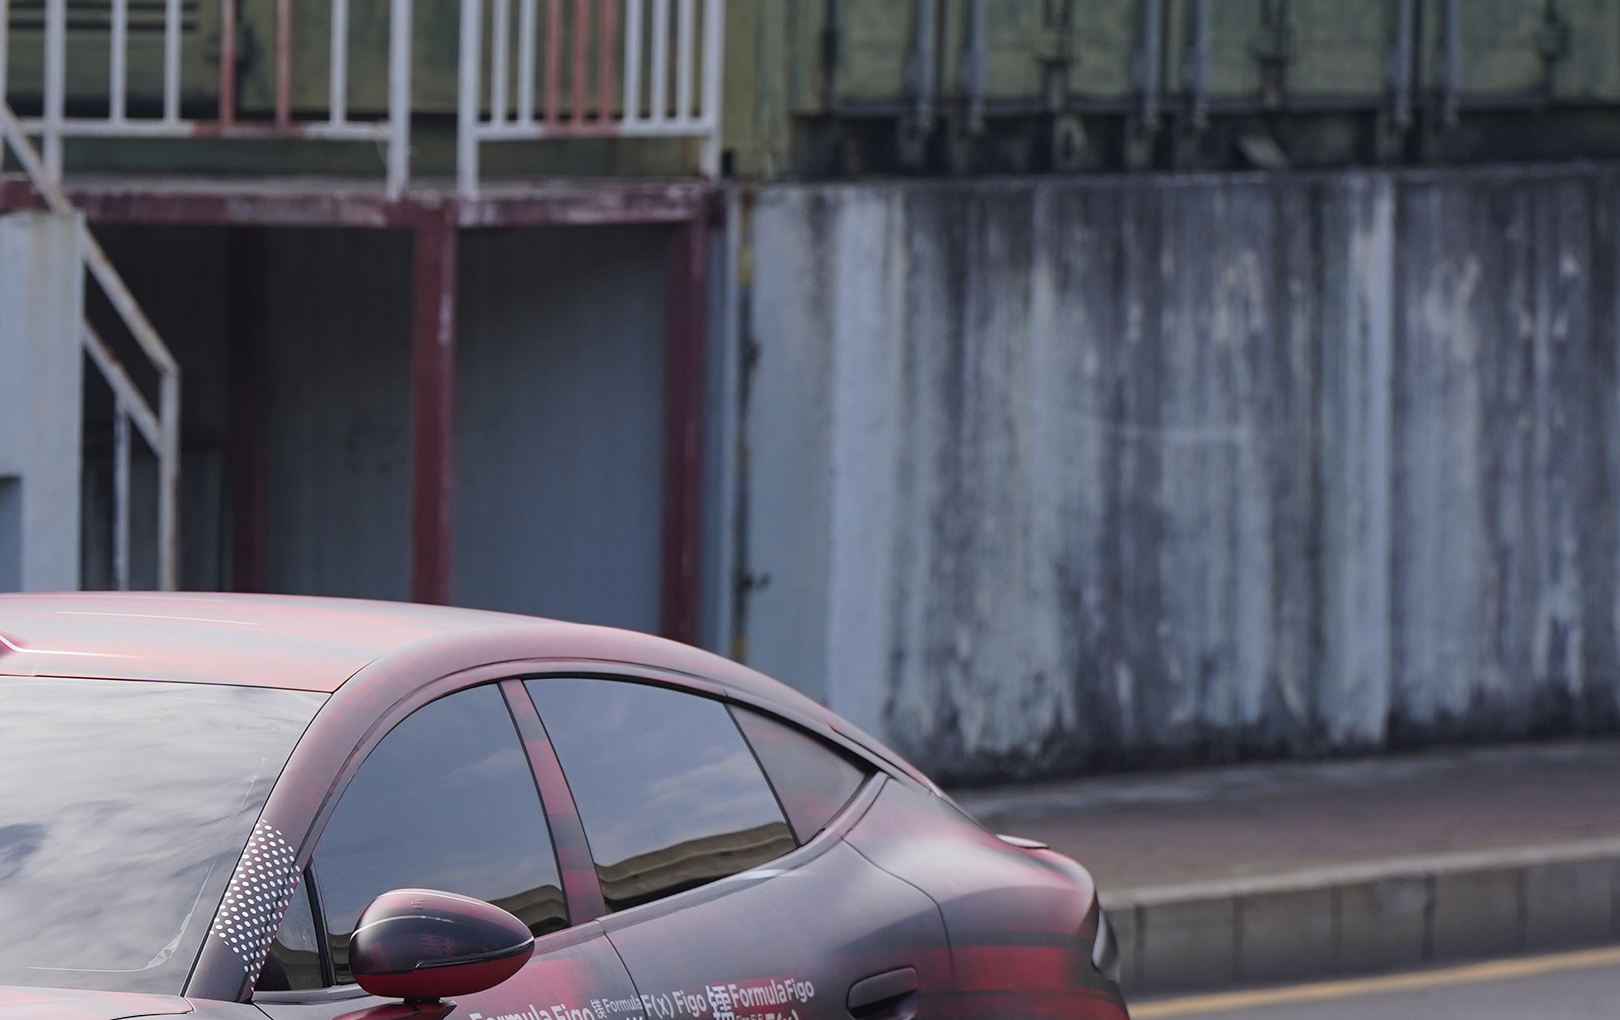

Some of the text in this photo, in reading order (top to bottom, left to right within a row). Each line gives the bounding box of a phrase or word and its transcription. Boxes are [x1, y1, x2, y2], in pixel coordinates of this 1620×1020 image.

[672, 990, 707, 1017] Figo
[728, 978, 815, 1009] Formula Figo
